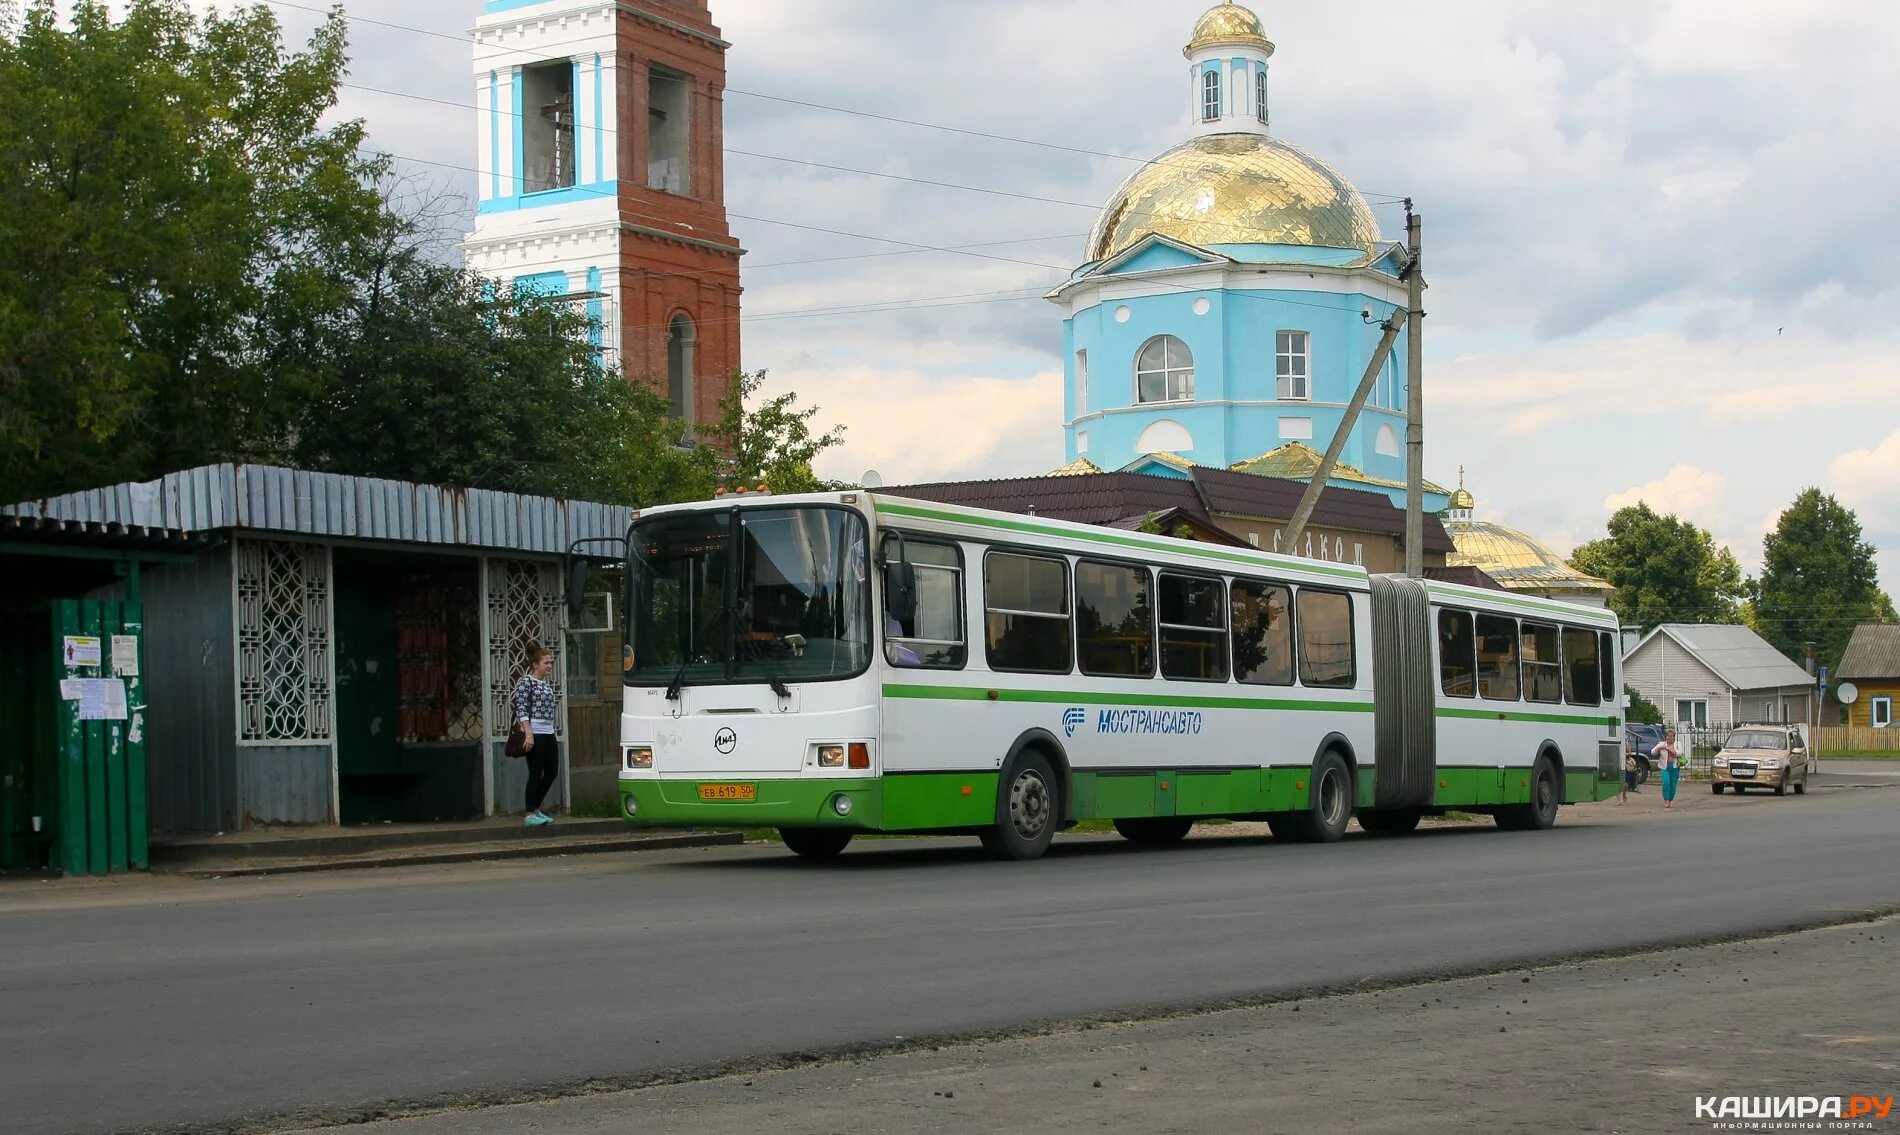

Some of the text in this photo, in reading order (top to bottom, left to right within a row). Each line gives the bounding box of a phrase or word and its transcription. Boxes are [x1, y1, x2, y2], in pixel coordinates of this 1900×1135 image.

[1097, 709, 1203, 734] МОСТРАНСАВТО
[718, 786, 736, 797] 619
[741, 785, 751, 794] 50
